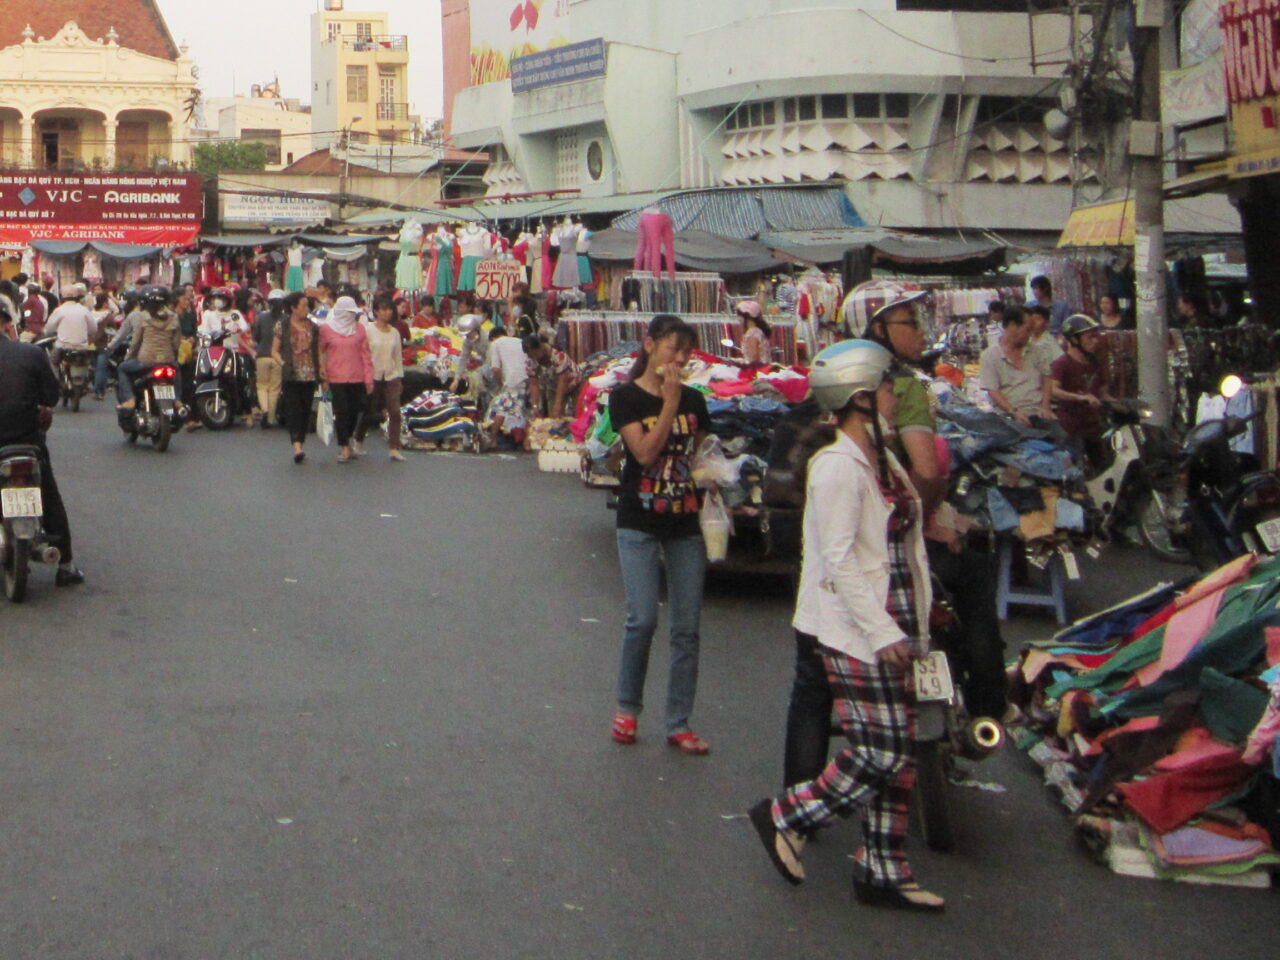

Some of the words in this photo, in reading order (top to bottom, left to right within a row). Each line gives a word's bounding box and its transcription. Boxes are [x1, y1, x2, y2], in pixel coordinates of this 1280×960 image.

[46, 190, 82, 203] VJC
[104, 190, 180, 203] AGRIBANK
[29, 230, 52, 238] VJC
[62, 230, 125, 238] AGRIBANK
